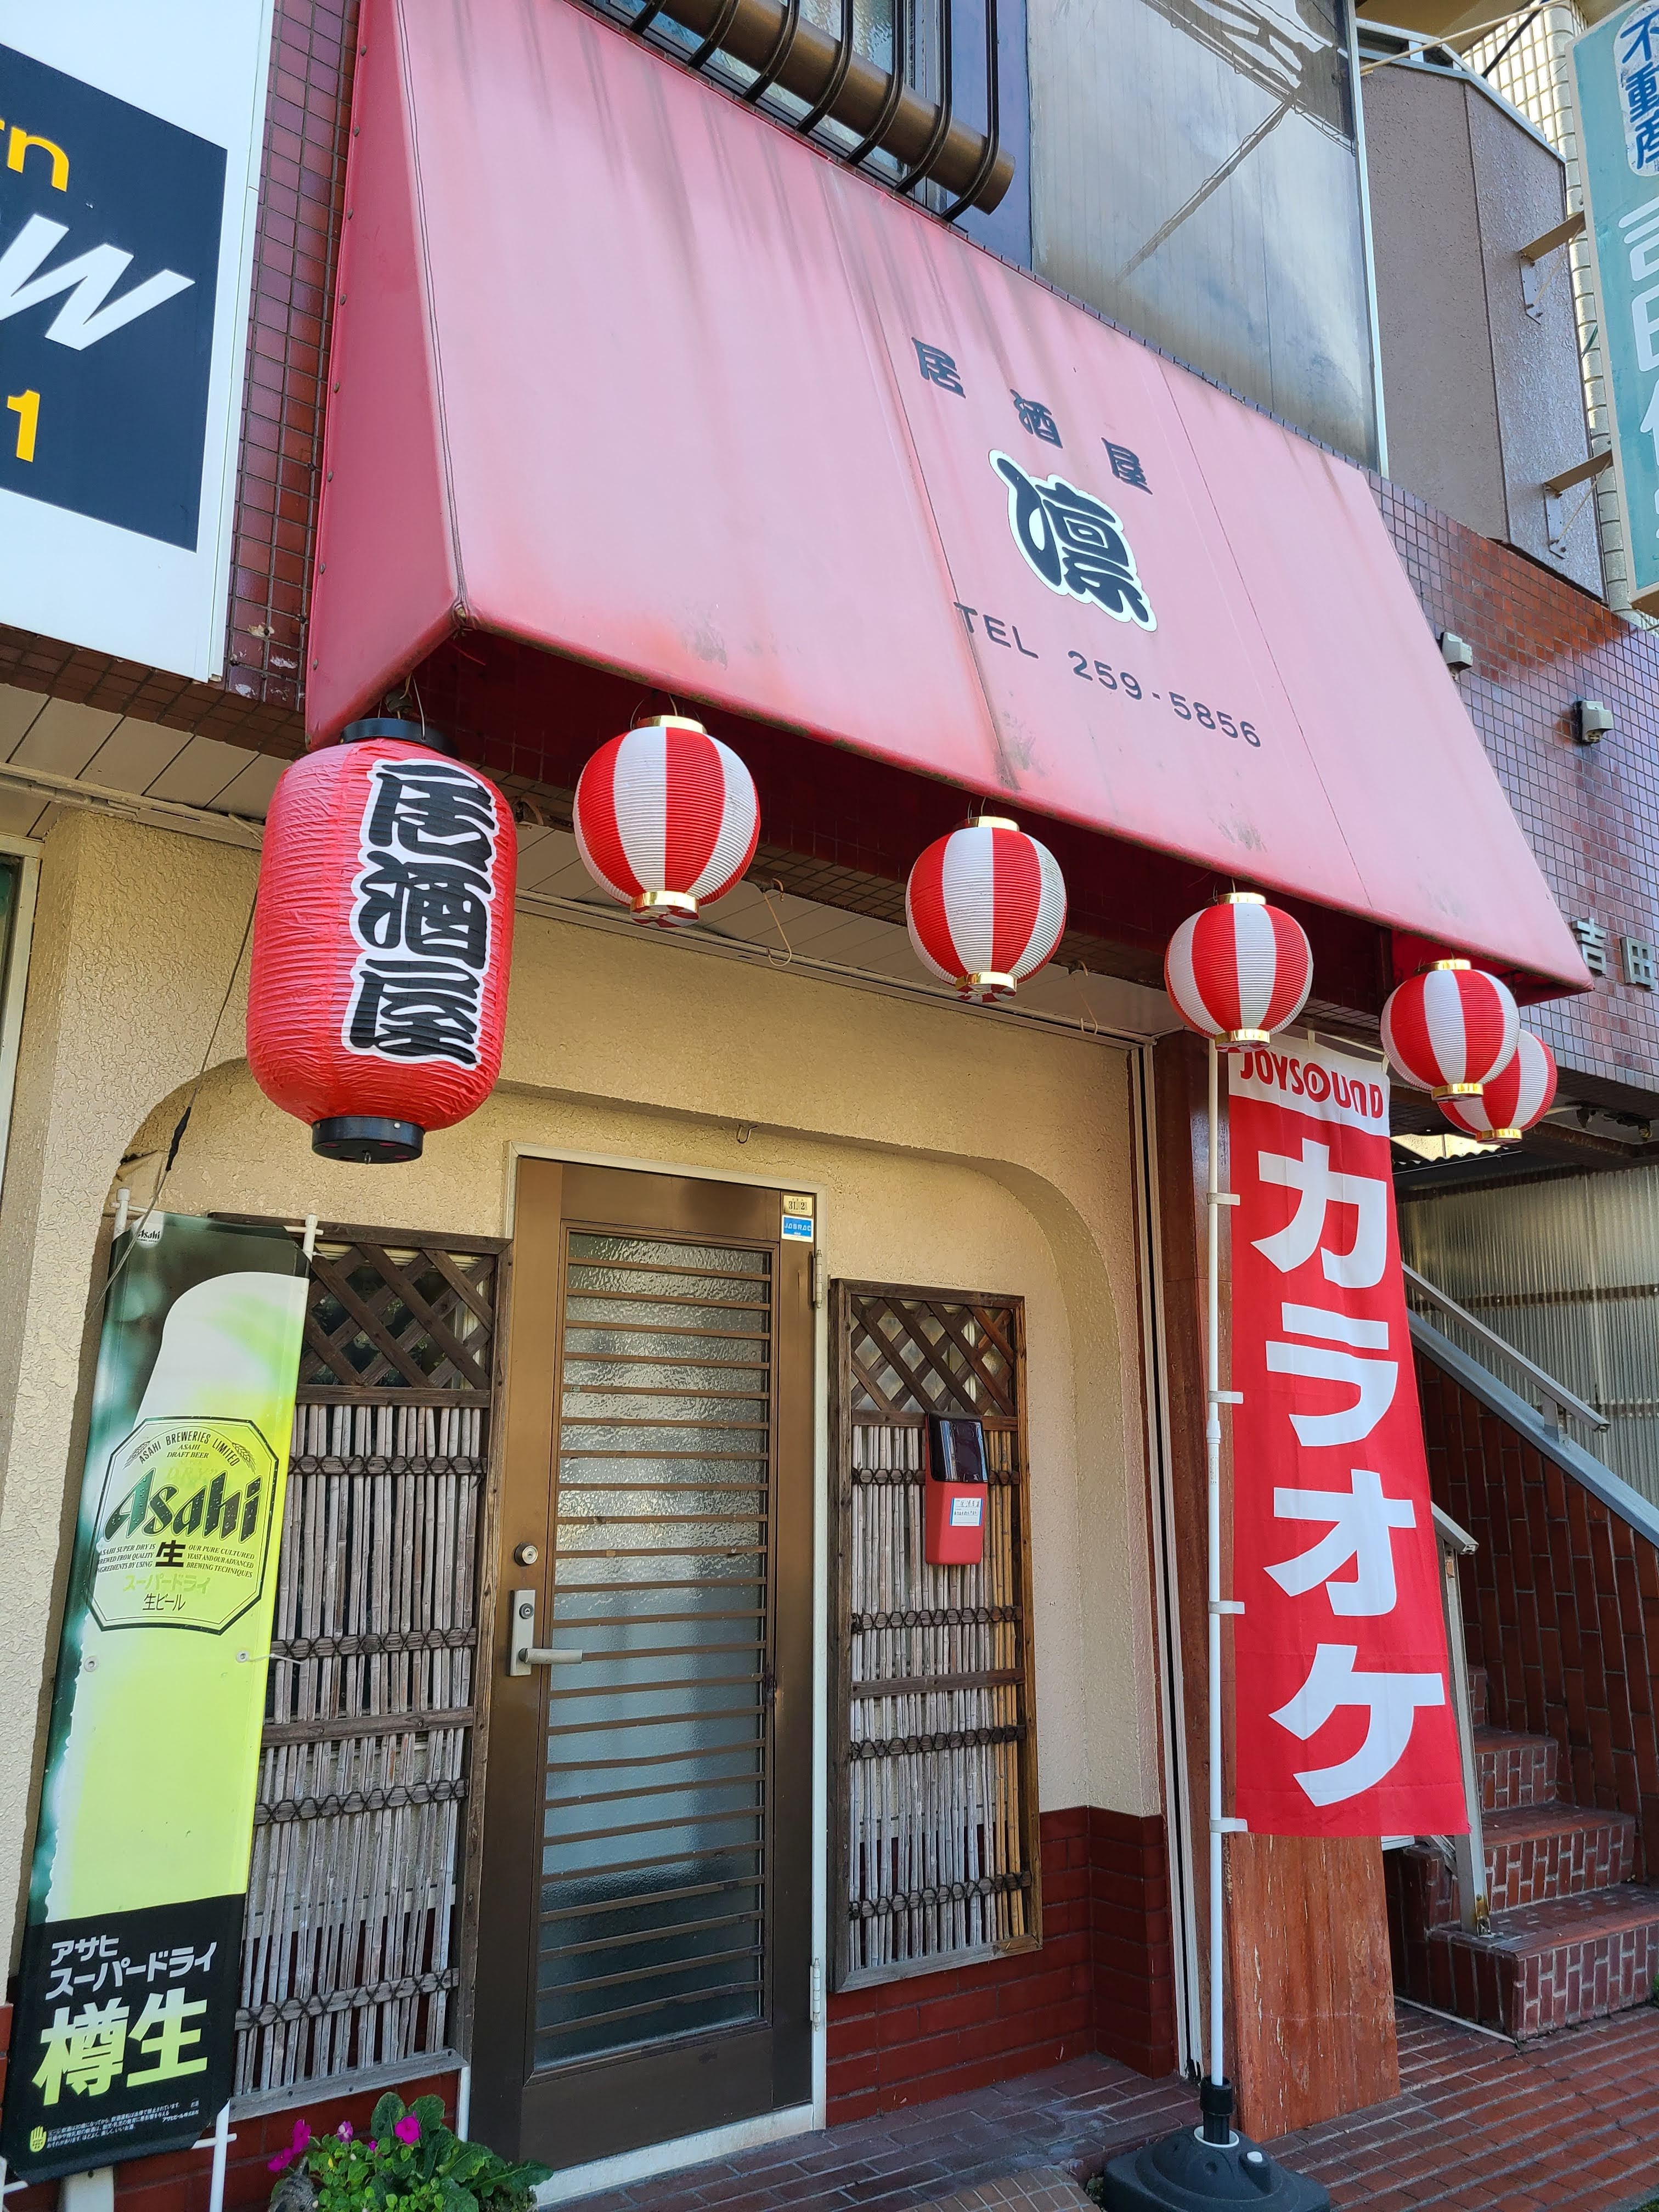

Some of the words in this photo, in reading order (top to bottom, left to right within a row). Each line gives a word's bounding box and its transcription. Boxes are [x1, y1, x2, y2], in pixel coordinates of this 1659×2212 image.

[0, 119, 69, 192] n
[7, 389, 40, 462] 1
[912, 337, 1153, 495] 居酒屋
[953, 602, 1039, 659] TEL
[345, 760, 498, 1069] 居酒屋
[1572, 917, 1657, 991] 吉田
[1240, 1048, 1384, 1119] JOYSOUND
[139, 1441, 162, 1464] ASAHI
[165, 1431, 211, 1446] BREWERIES
[212, 1438, 240, 1466] LIMITED
[1250, 1137, 1446, 1807] カラオケ
[104, 1468, 262, 1544] Asahi
[116, 1544, 135, 1553] SUPER
[132, 1552, 154, 1561] QUALITY
[155, 1540, 187, 1567] 生
[186, 1561, 214, 1571] BREWING
[214, 1565, 253, 1578] TECHNIQUES
[221, 1548, 255, 1560] CULTURED
[225, 1558, 254, 1569] ADVANCED
[123, 1573, 211, 1594] スーパードライ
[142, 1593, 187, 1611] 生ビール
[46, 1942, 217, 2000] スーパードライ
[50, 1934, 120, 1966] アサヒ
[32, 1987, 208, 2106] 樽生
